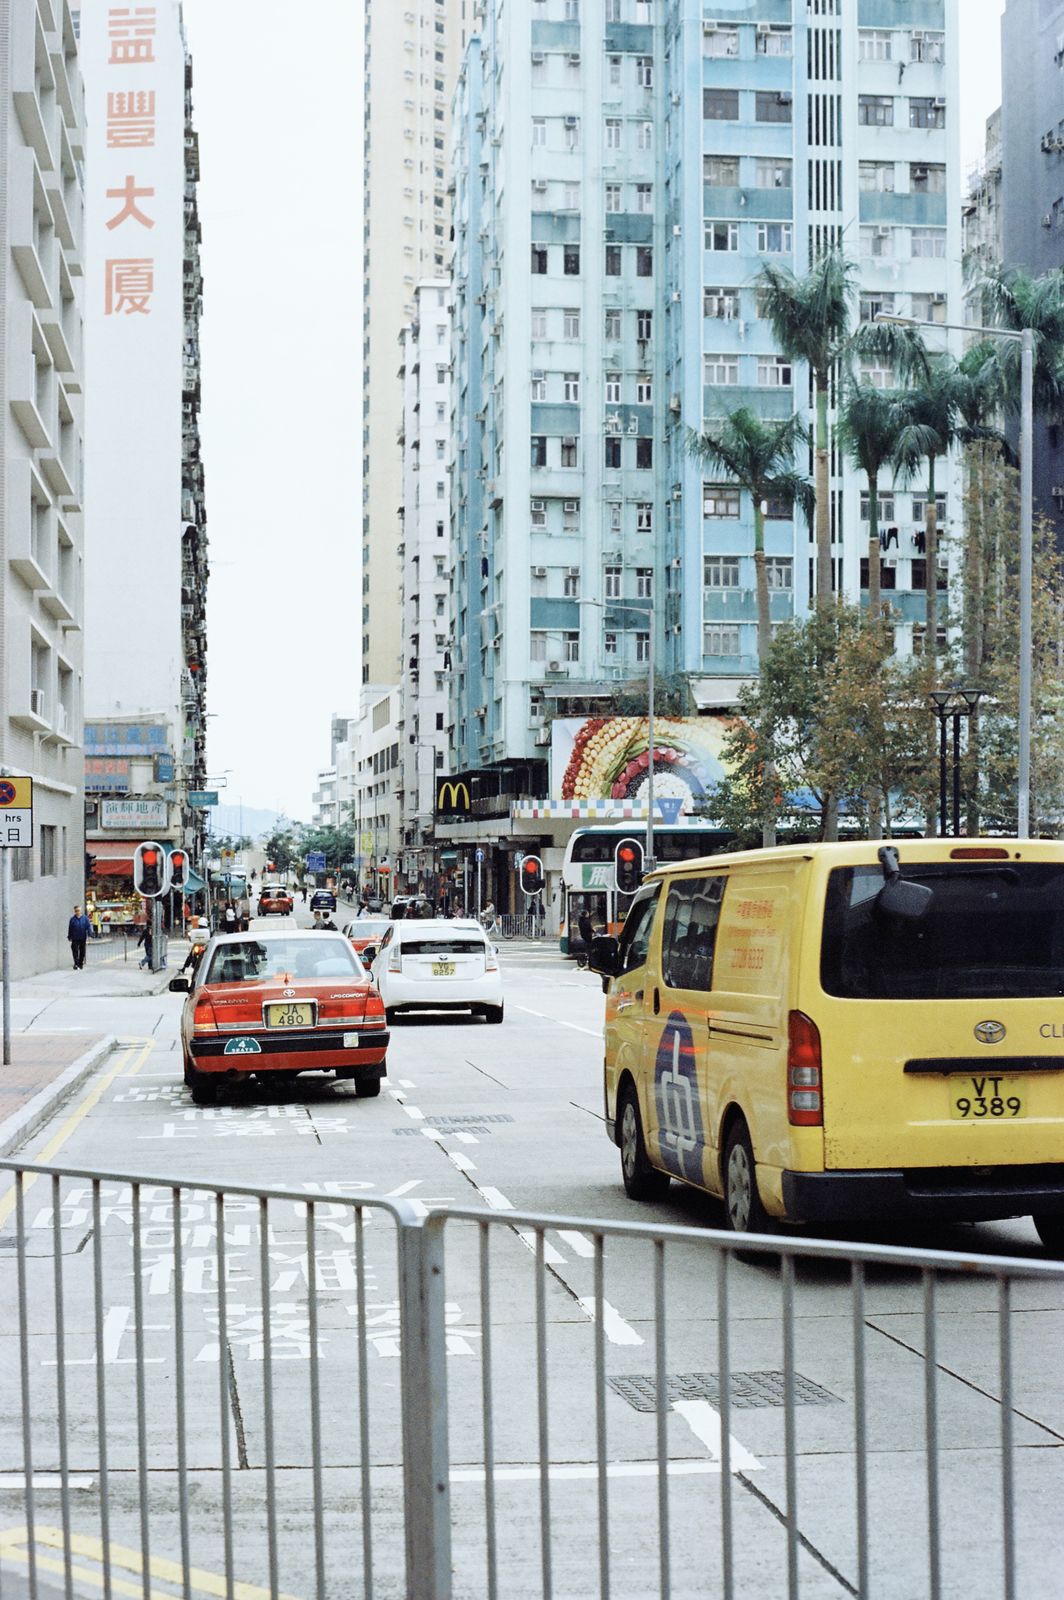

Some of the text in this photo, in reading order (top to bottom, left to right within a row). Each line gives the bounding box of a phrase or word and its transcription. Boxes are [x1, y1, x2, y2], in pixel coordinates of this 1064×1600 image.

[5, 814, 22, 822] hrs
[283, 1004, 299, 1015] JA
[278, 1015, 304, 1025] 480
[1039, 1023, 1064, 1039] CL
[971, 1077, 1003, 1097] VT
[956, 1097, 1021, 1117] 9389
[128, 1221, 372, 1248] ONLY
